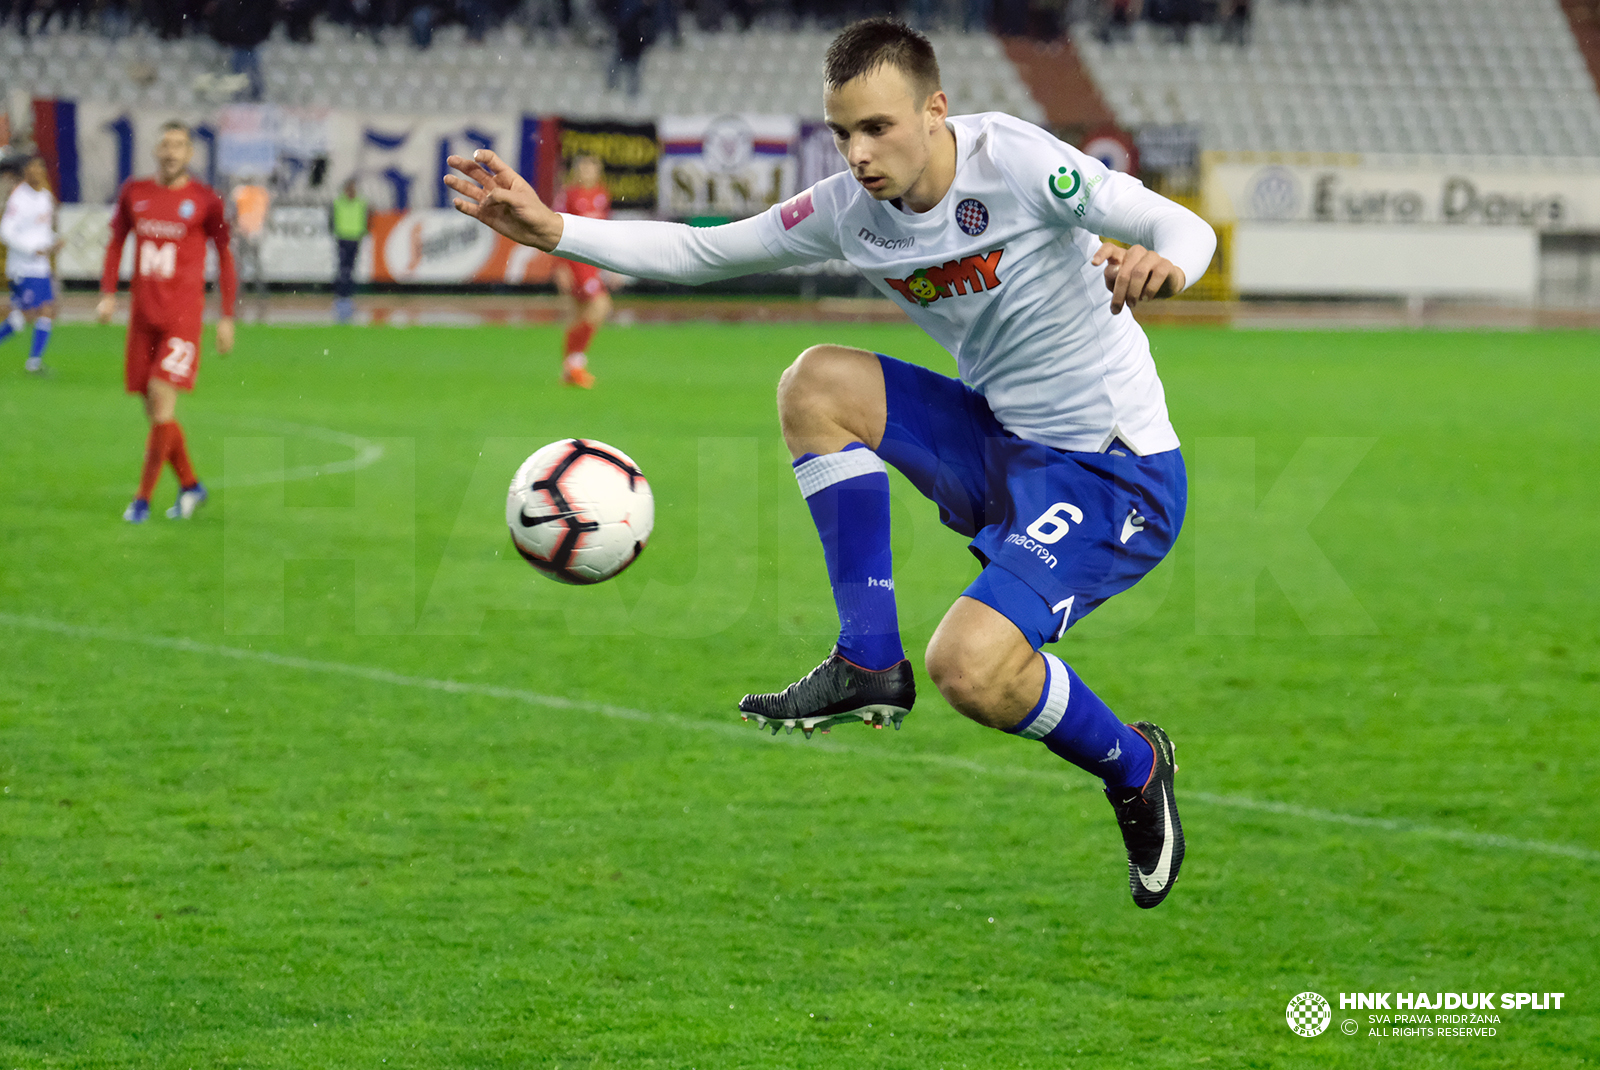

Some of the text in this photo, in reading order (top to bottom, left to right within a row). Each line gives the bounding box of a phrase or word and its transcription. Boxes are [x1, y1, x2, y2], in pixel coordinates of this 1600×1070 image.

[1313, 171, 1425, 222] Euro
[139, 239, 178, 279] M
[857, 227, 915, 250] macron
[884, 248, 1005, 305] TOMMY
[1026, 502, 1084, 545] 6
[1005, 533, 1058, 569] macron
